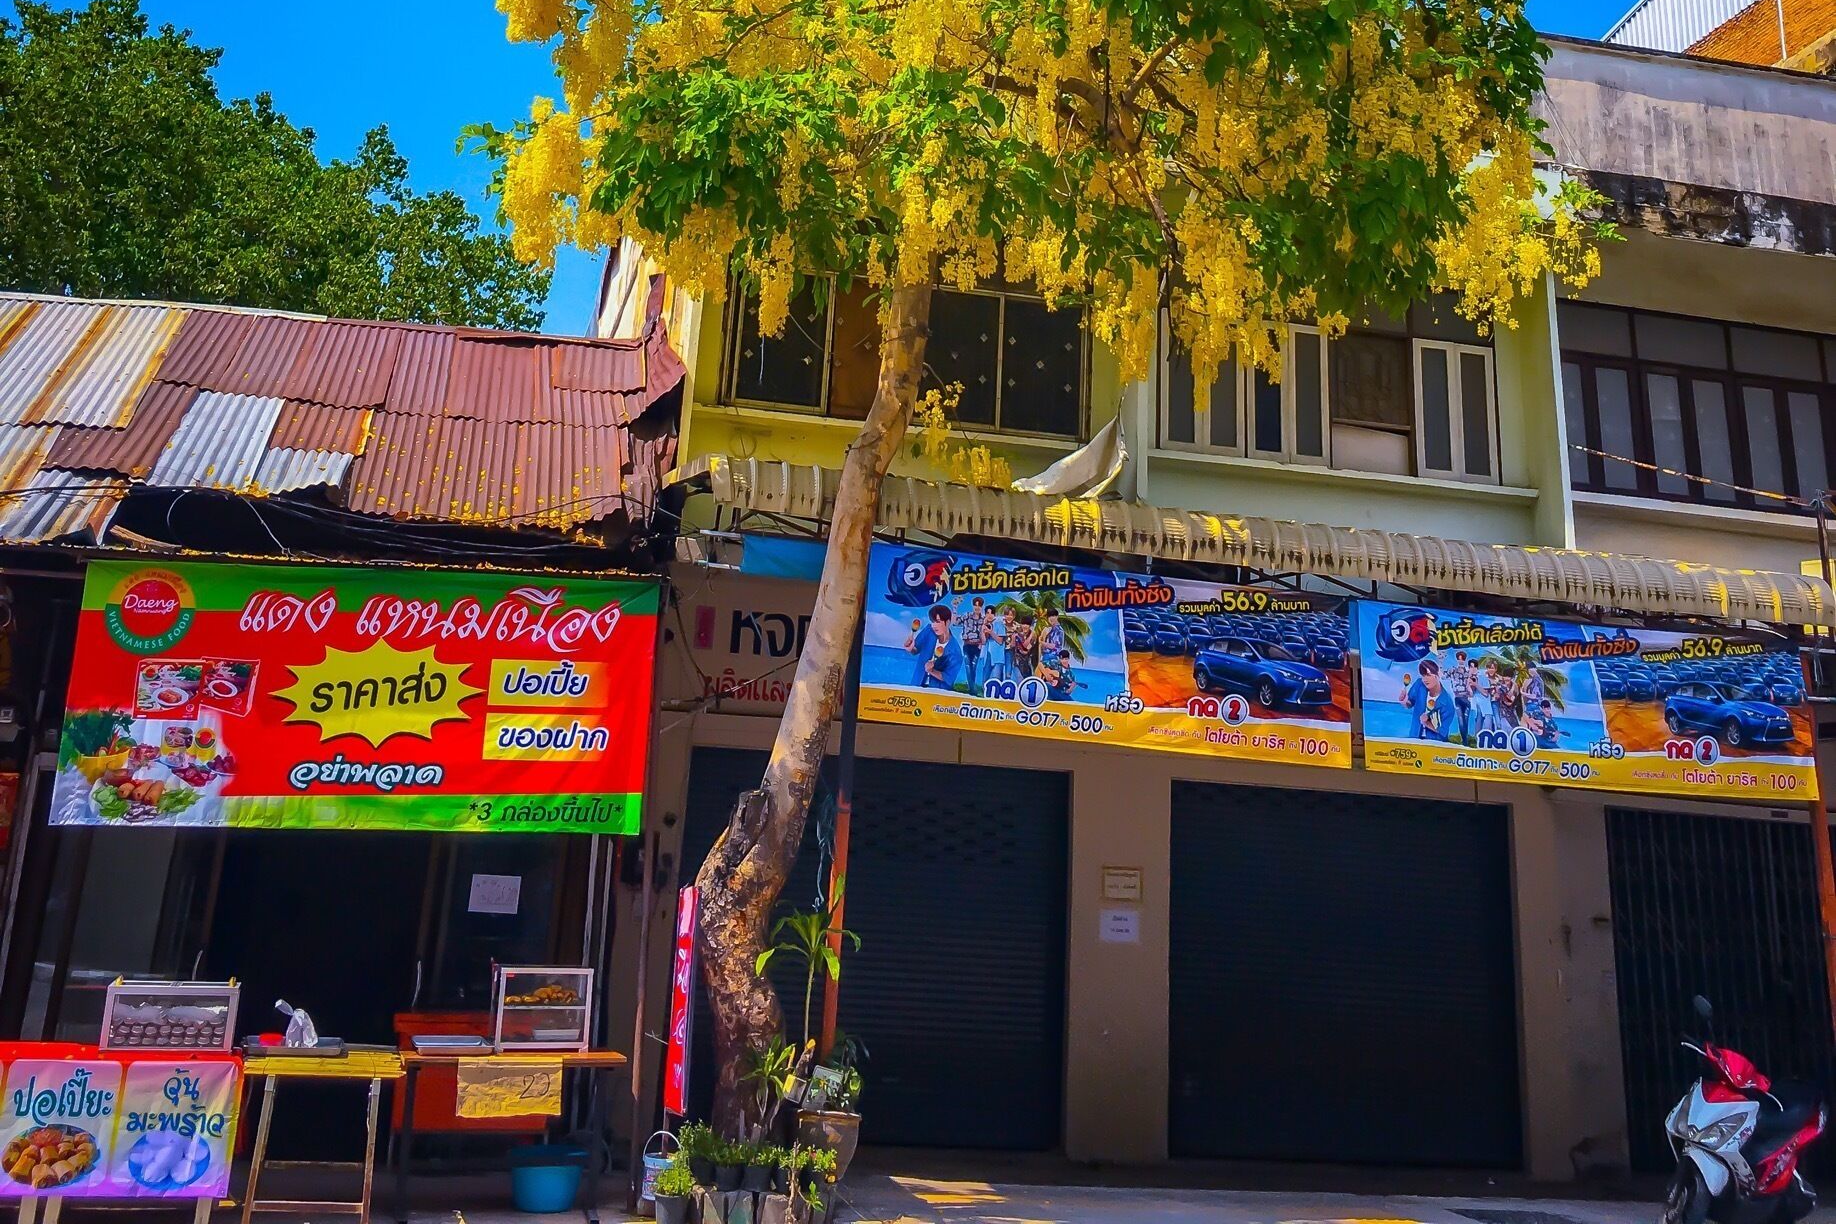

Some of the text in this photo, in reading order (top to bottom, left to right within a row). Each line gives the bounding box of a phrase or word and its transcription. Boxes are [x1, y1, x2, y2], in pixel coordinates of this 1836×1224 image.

[124, 594, 178, 612] Daeng
[1223, 592, 1267, 612] 56.9
[1271, 599, 1310, 611] ล้านบาท
[109, 610, 190, 649] VIETNAMESE FOOD
[239, 587, 621, 652] แดง แหนมเนือง
[1683, 638, 1723, 658] 56.9
[1725, 643, 1763, 656] ล้านบาท
[310, 662, 447, 713] ราคาส่ง
[985, 680, 1016, 700] กด
[1105, 690, 1144, 713] หรือ
[1189, 698, 1219, 718] กด
[960, 702, 1004, 720] ติดเกาะ
[1016, 710, 1060, 727] GOT7
[1070, 714, 1103, 733] 500
[498, 723, 609, 750] ของฝาก
[1204, 726, 1248, 746] โตโยต้า
[1252, 734, 1286, 750] ยาริส
[1299, 738, 1329, 756] 100
[1478, 731, 1507, 750] กด
[1588, 737, 1625, 759] หรือ
[1667, 741, 1693, 759] กด
[290, 755, 444, 790] อย่าพลาด
[1456, 754, 1497, 770] ติดเกาะ
[1508, 759, 1551, 774] GOT7
[1560, 762, 1590, 778] 500
[1682, 768, 1723, 785] โตโยต้า
[1727, 772, 1758, 786] ยาริส
[1770, 774, 1797, 790] 100
[14, 1068, 114, 1126] ปอเปี๊ยะ
[164, 1068, 200, 1106] วุ้น
[127, 1105, 225, 1139] มะพร้าว
